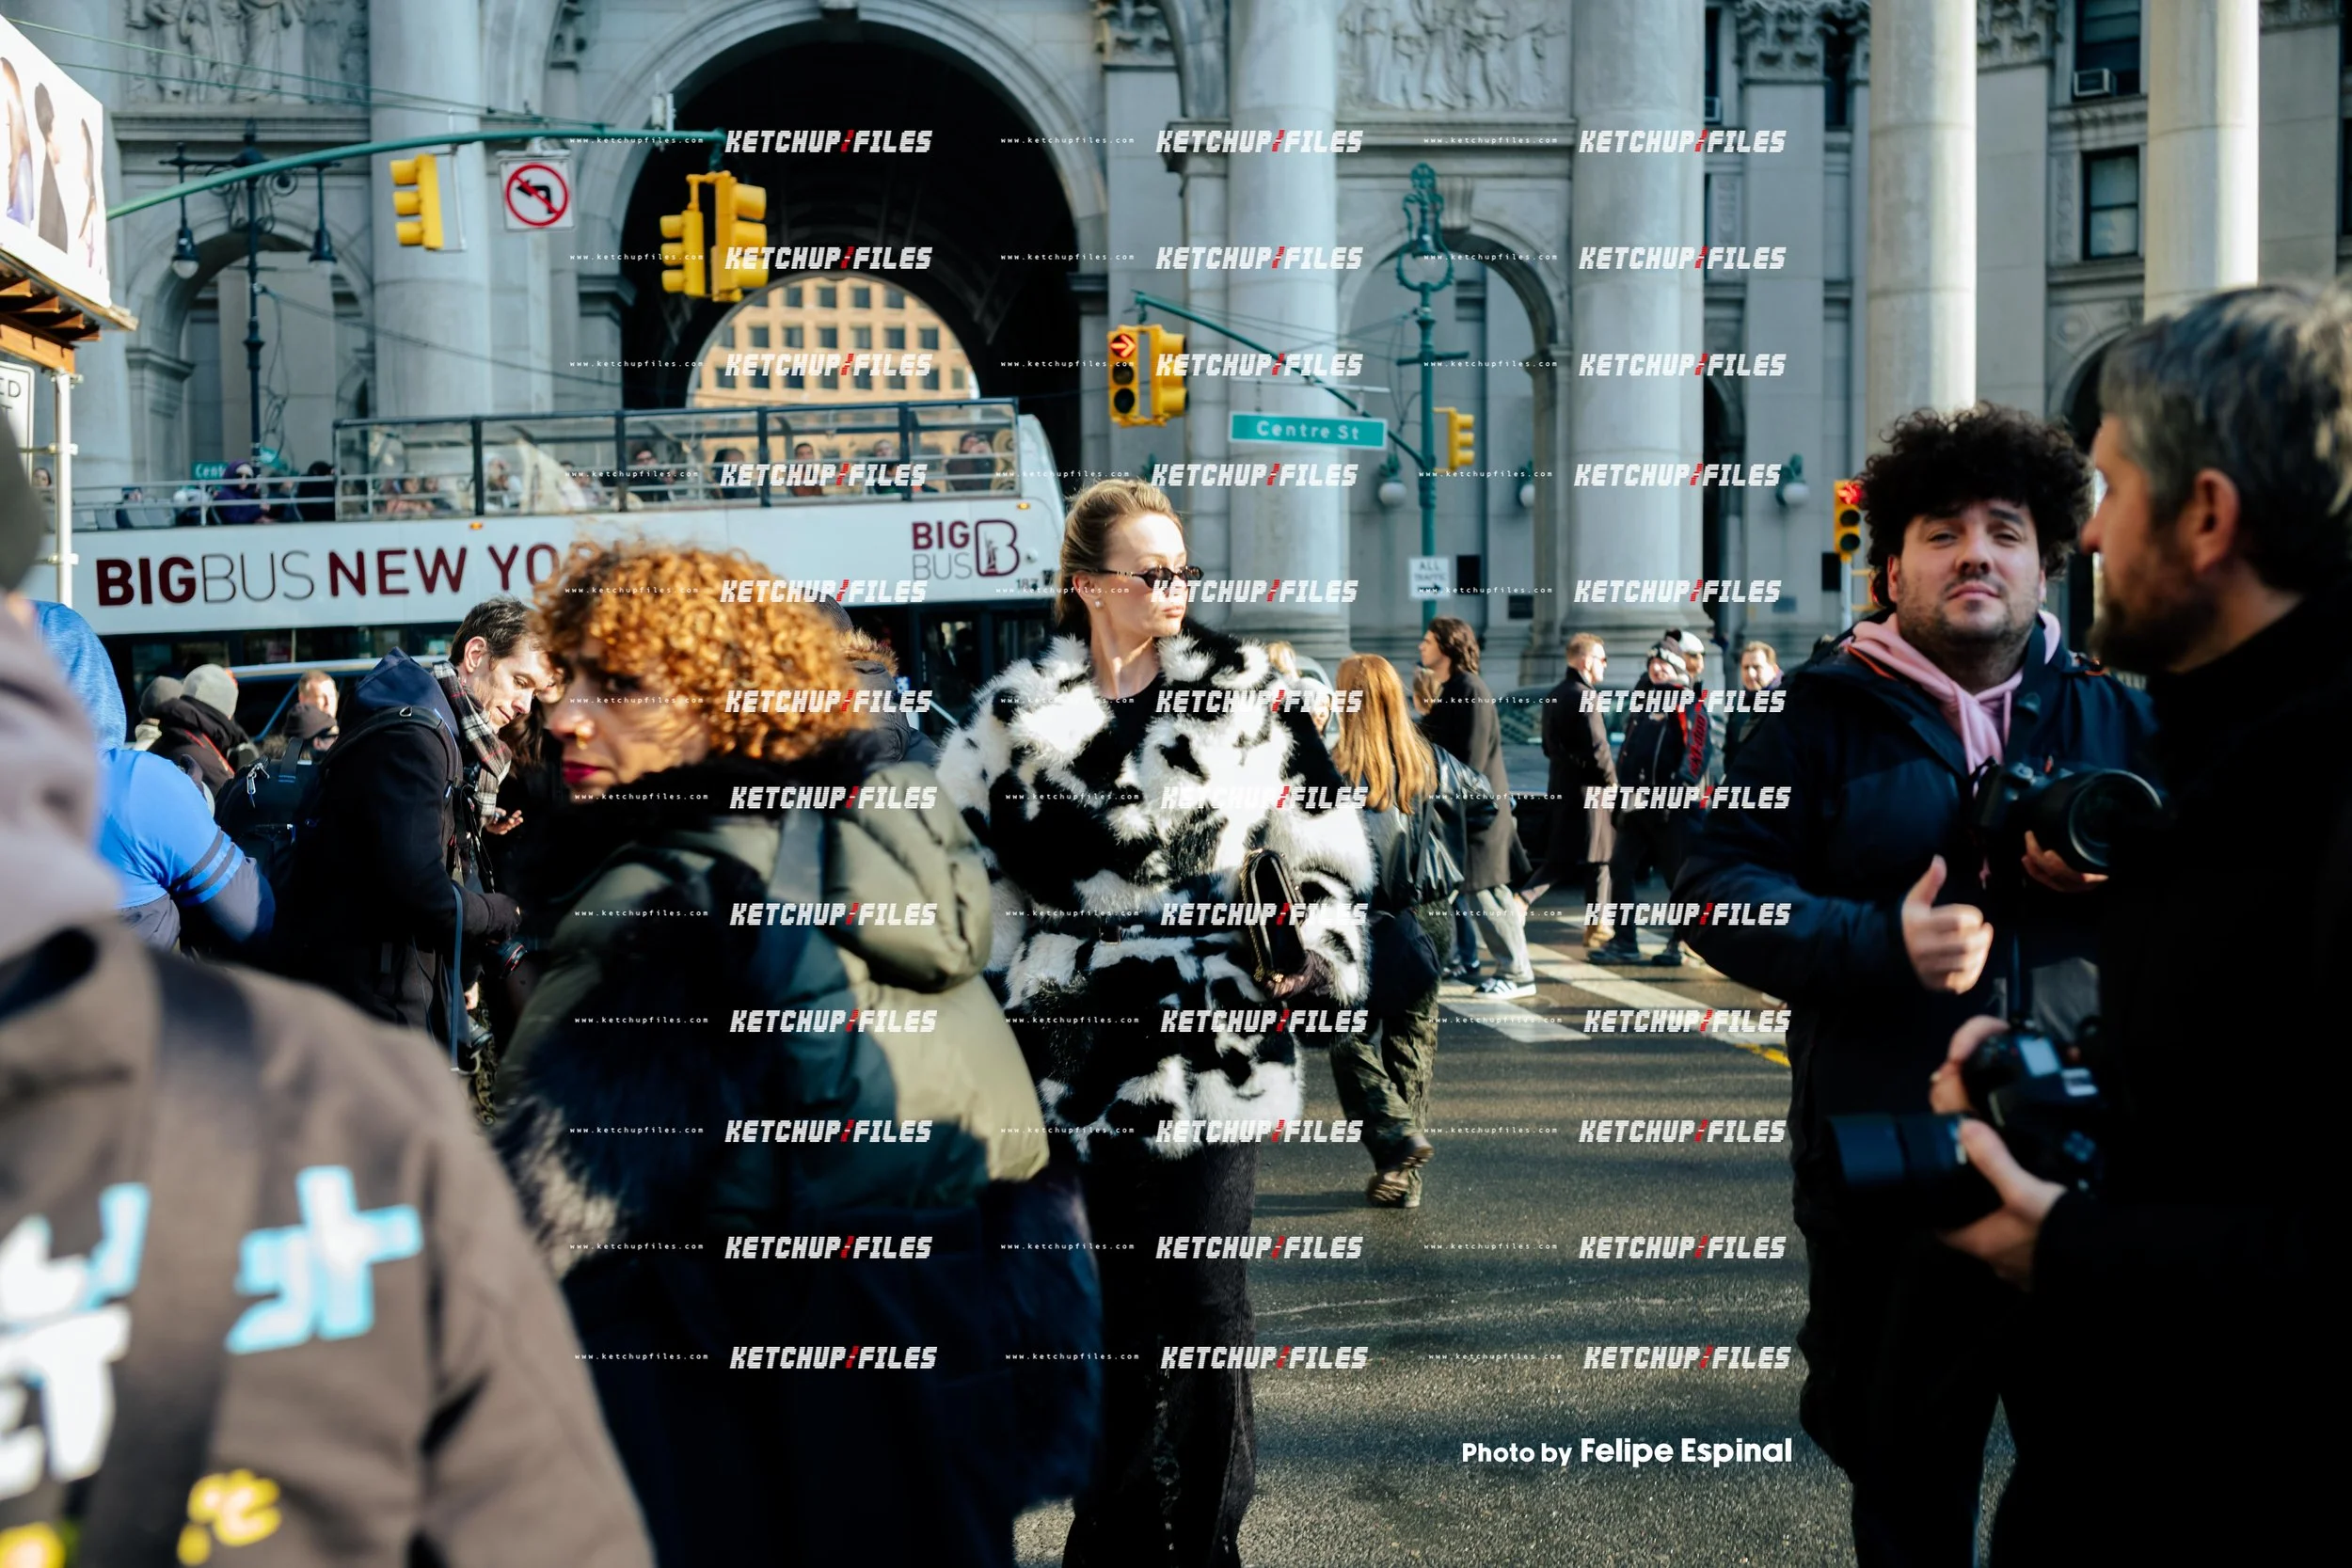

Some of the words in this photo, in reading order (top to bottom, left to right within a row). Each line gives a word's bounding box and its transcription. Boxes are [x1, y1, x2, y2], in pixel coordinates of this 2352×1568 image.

[0, 377, 22, 398] D
[1256, 420, 1330, 439] Centre
[1337, 424, 1360, 441] St
[912, 520, 970, 550] BIG
[328, 545, 468, 597] NEW
[487, 543, 562, 591] YO
[912, 552, 973, 581] BUS
